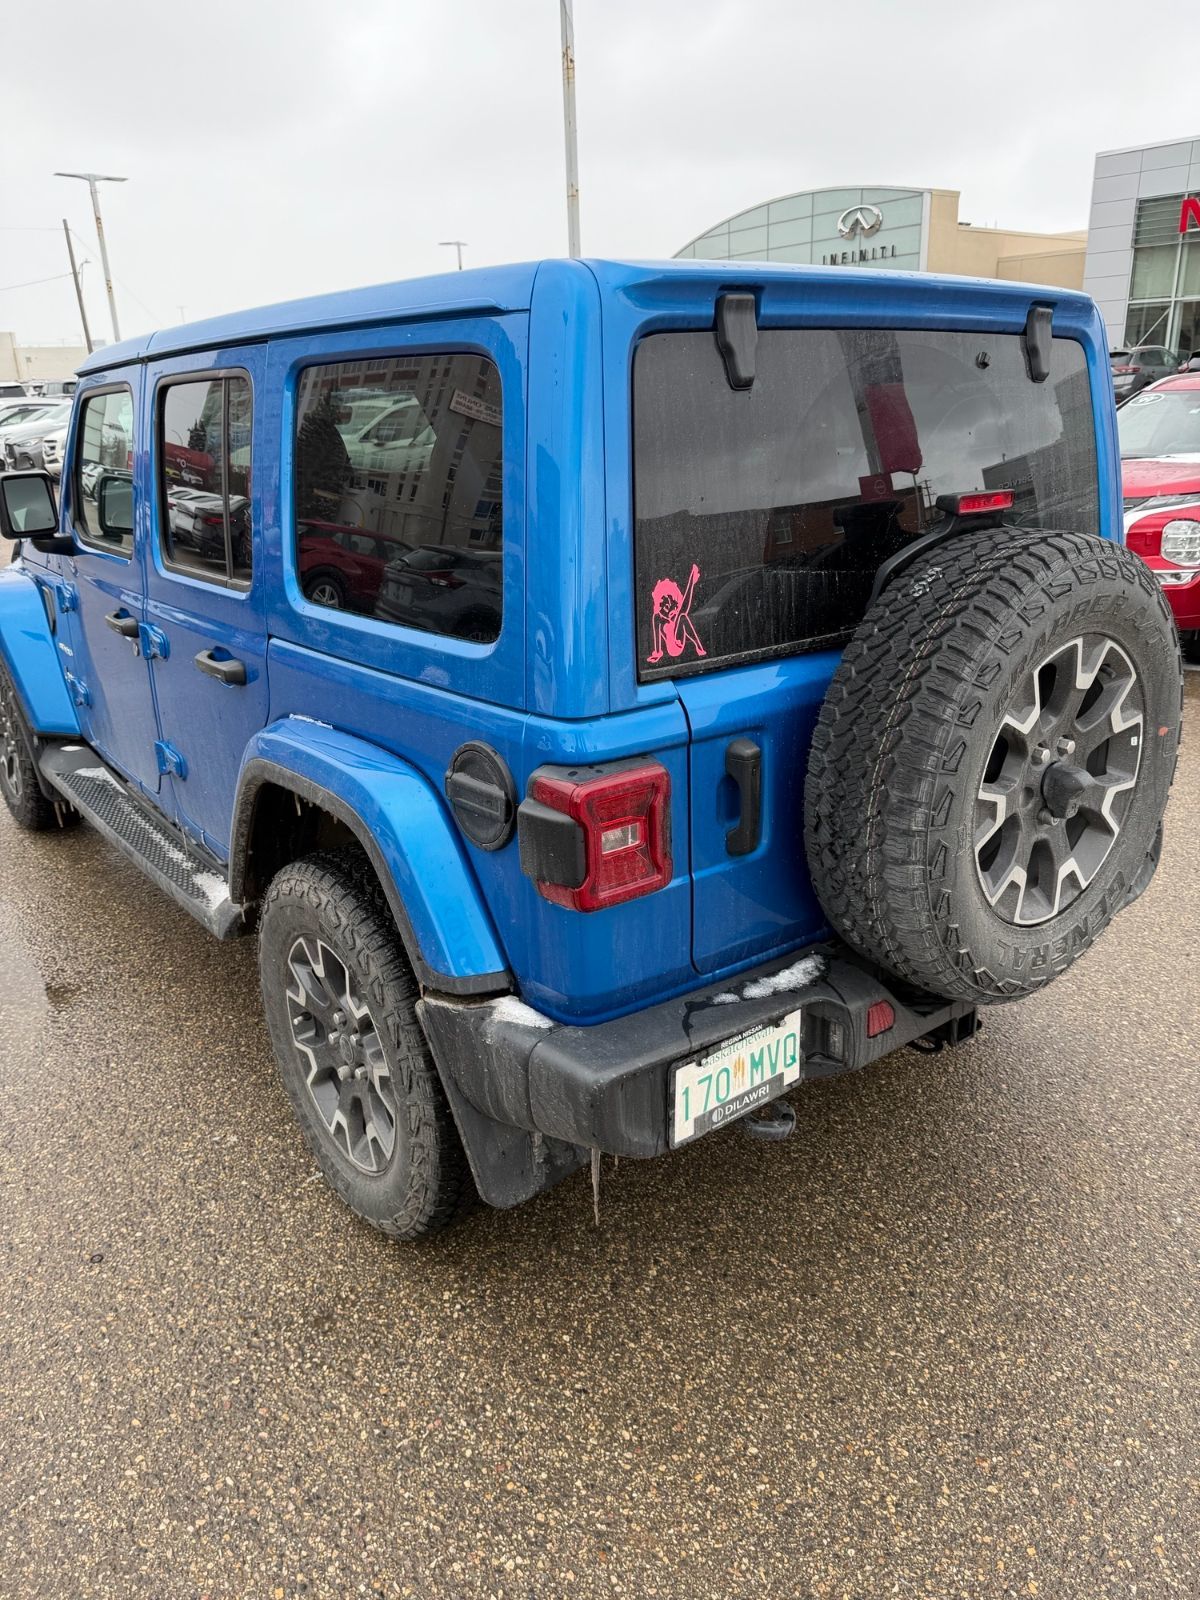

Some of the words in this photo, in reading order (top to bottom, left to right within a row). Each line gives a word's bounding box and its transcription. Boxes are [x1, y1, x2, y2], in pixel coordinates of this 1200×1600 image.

[822, 244, 896, 266] INFINITI
[996, 870, 1127, 970] GENERAL
[721, 1034, 742, 1049] REGINA
[742, 1023, 763, 1038] NISSAN
[681, 1066, 731, 1122] 170
[749, 1032, 797, 1087] MVQ
[725, 1084, 769, 1115] DILAWRI
